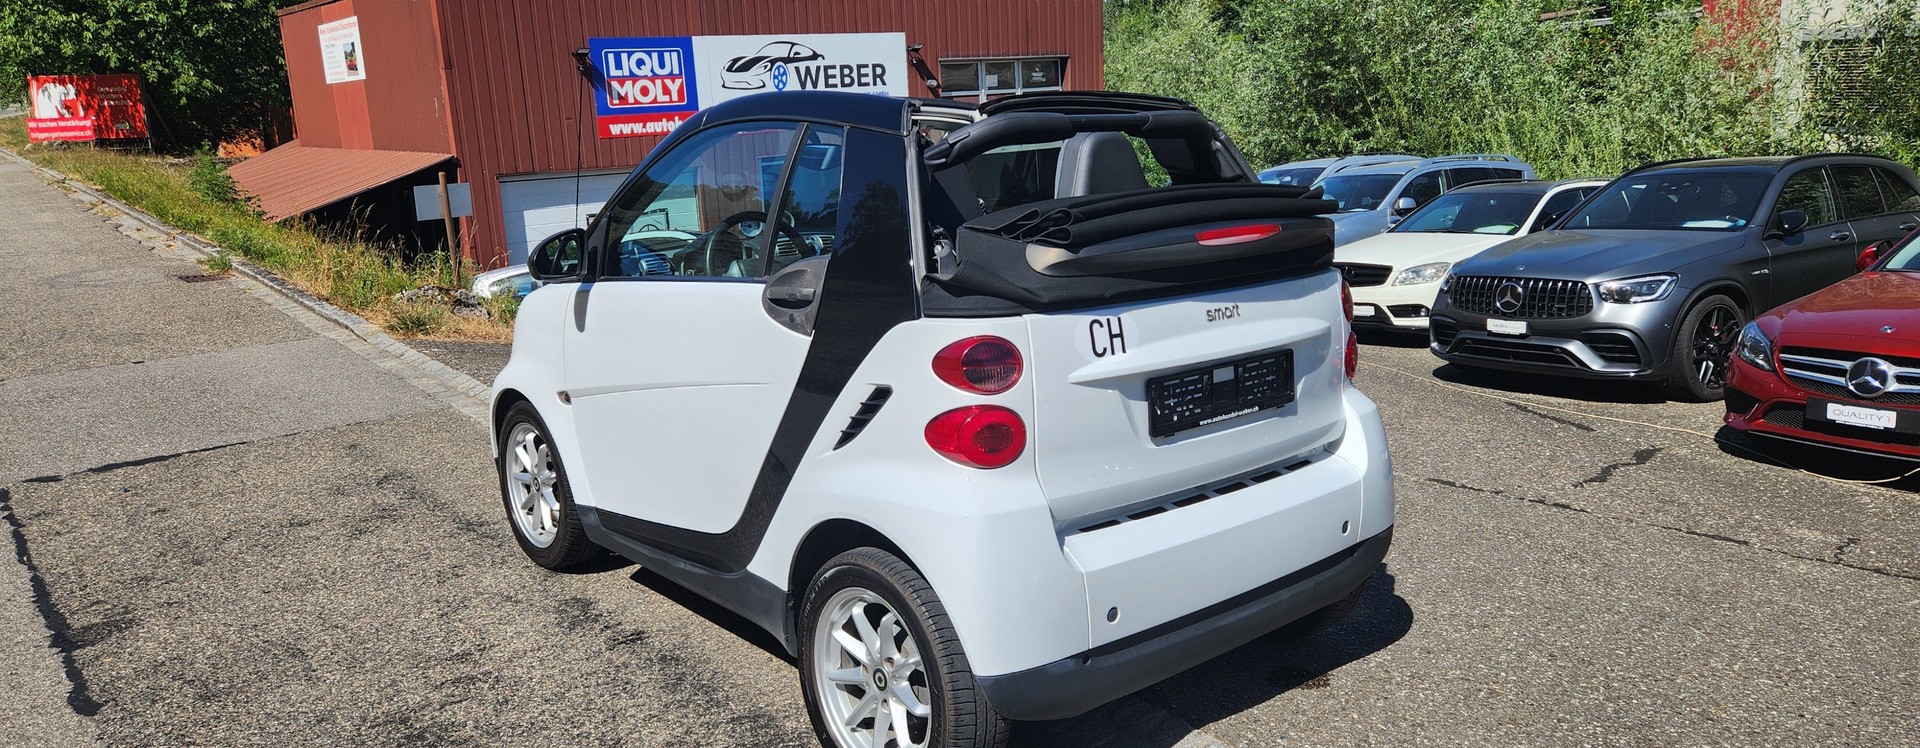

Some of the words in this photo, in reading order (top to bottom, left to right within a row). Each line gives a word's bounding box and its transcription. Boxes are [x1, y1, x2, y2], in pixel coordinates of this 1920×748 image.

[607, 51, 680, 77] LIQUI
[794, 63, 887, 89] WEBER
[610, 79, 683, 104] MOLY
[1206, 302, 1241, 322] smart
[1089, 316, 1127, 358] CH
[1833, 408, 1884, 421] QUALITY
